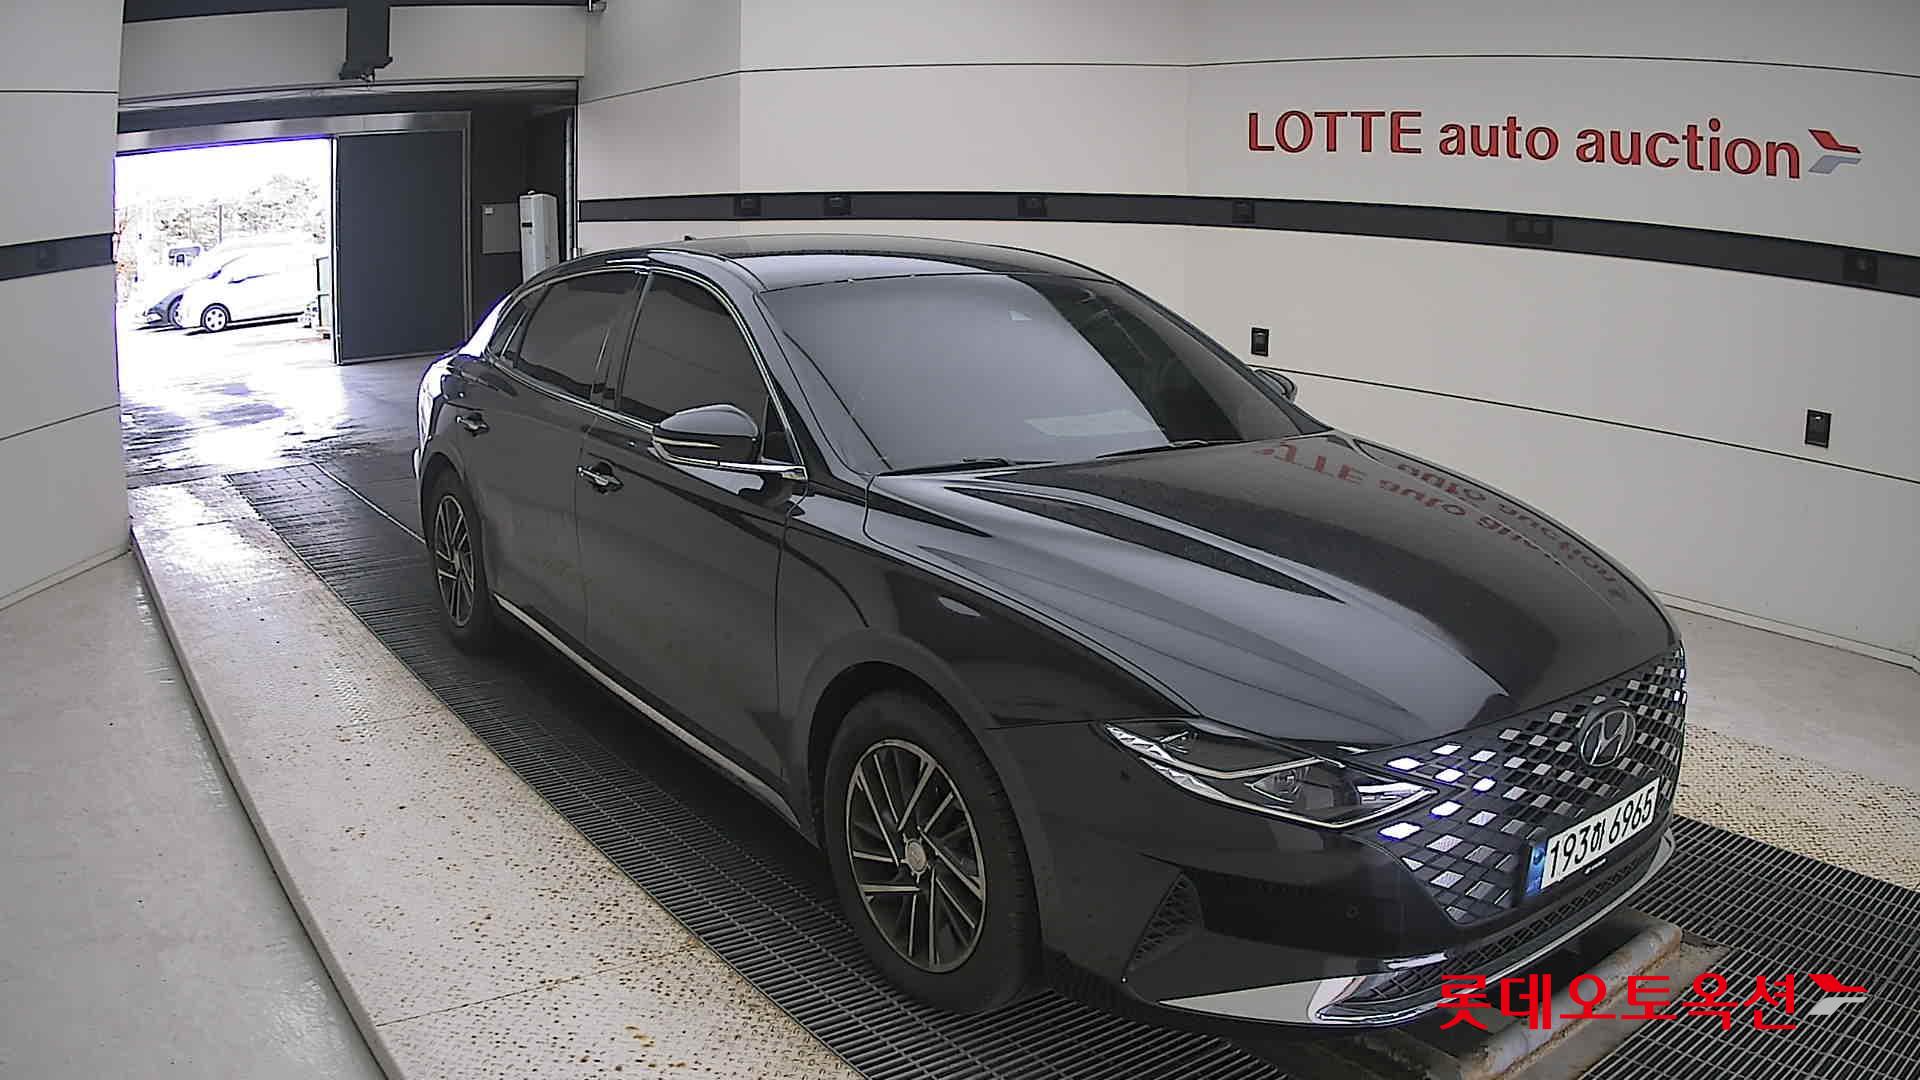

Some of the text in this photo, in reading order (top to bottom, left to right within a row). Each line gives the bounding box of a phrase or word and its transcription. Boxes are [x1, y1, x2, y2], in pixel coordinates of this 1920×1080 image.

[1248, 111, 1801, 180] LOTTE auto auction
[1551, 786, 1656, 878] 193하 6965
